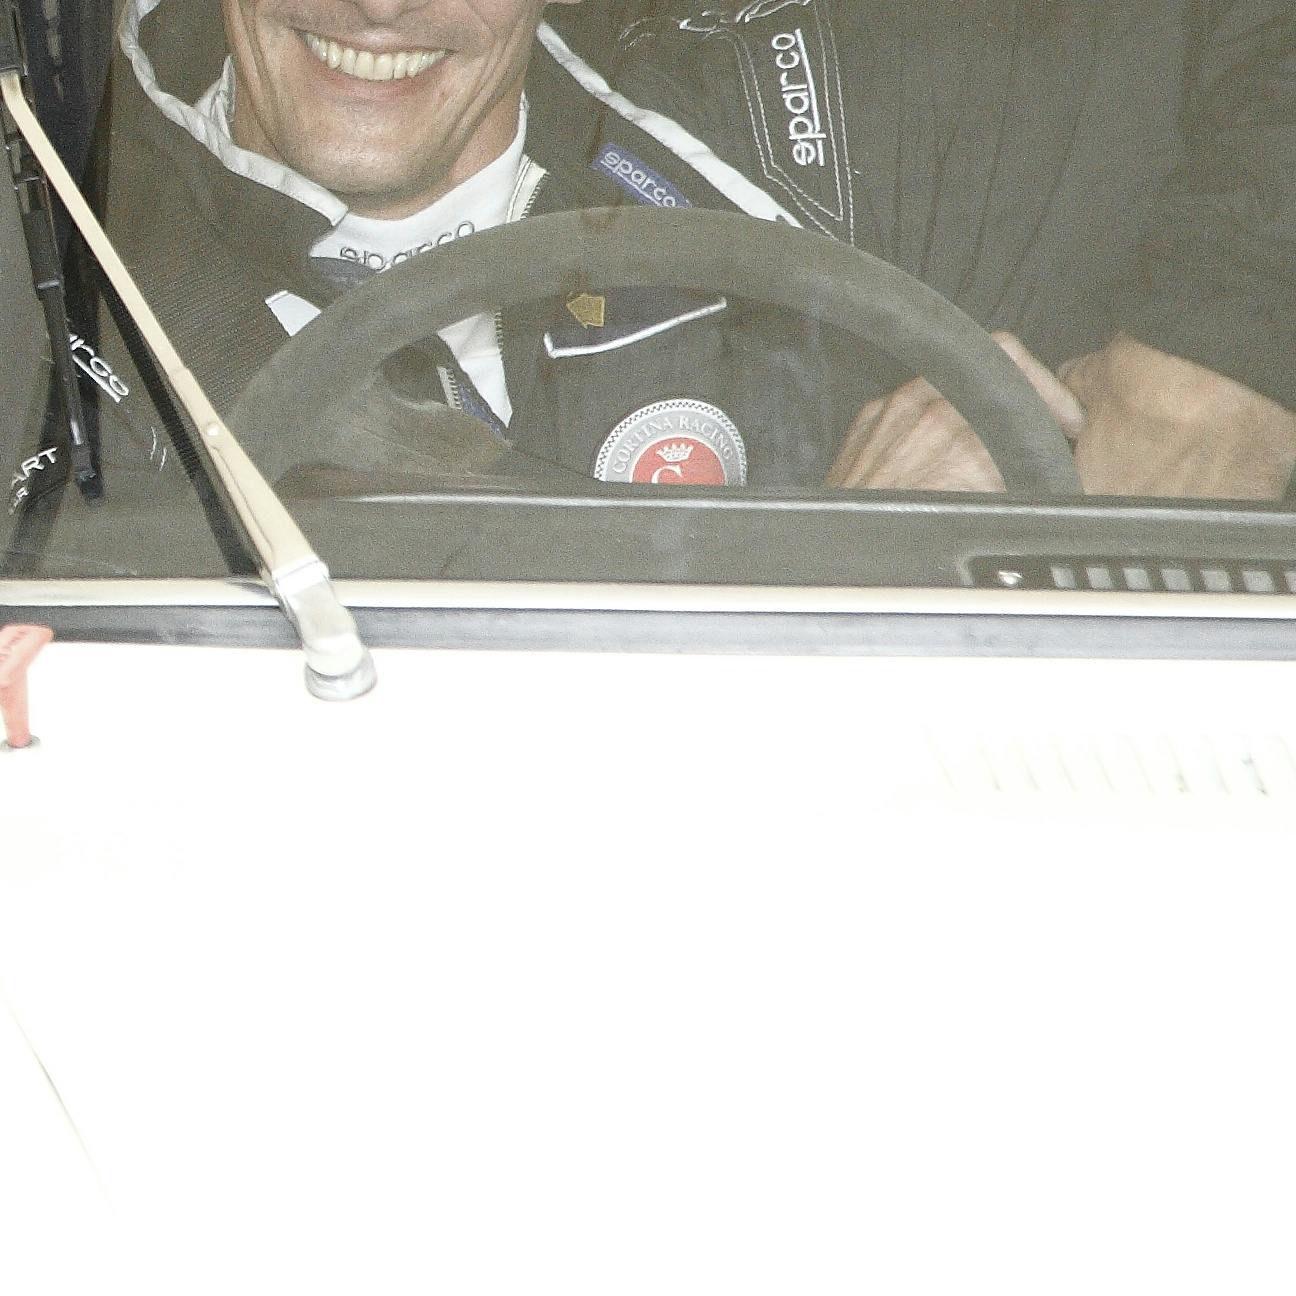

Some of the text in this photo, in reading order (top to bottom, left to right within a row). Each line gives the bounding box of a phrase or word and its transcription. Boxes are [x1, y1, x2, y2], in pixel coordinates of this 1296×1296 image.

[771, 32, 827, 166] sparco
[604, 151, 676, 207] sparco
[611, 415, 735, 474] CORTINA RACING
